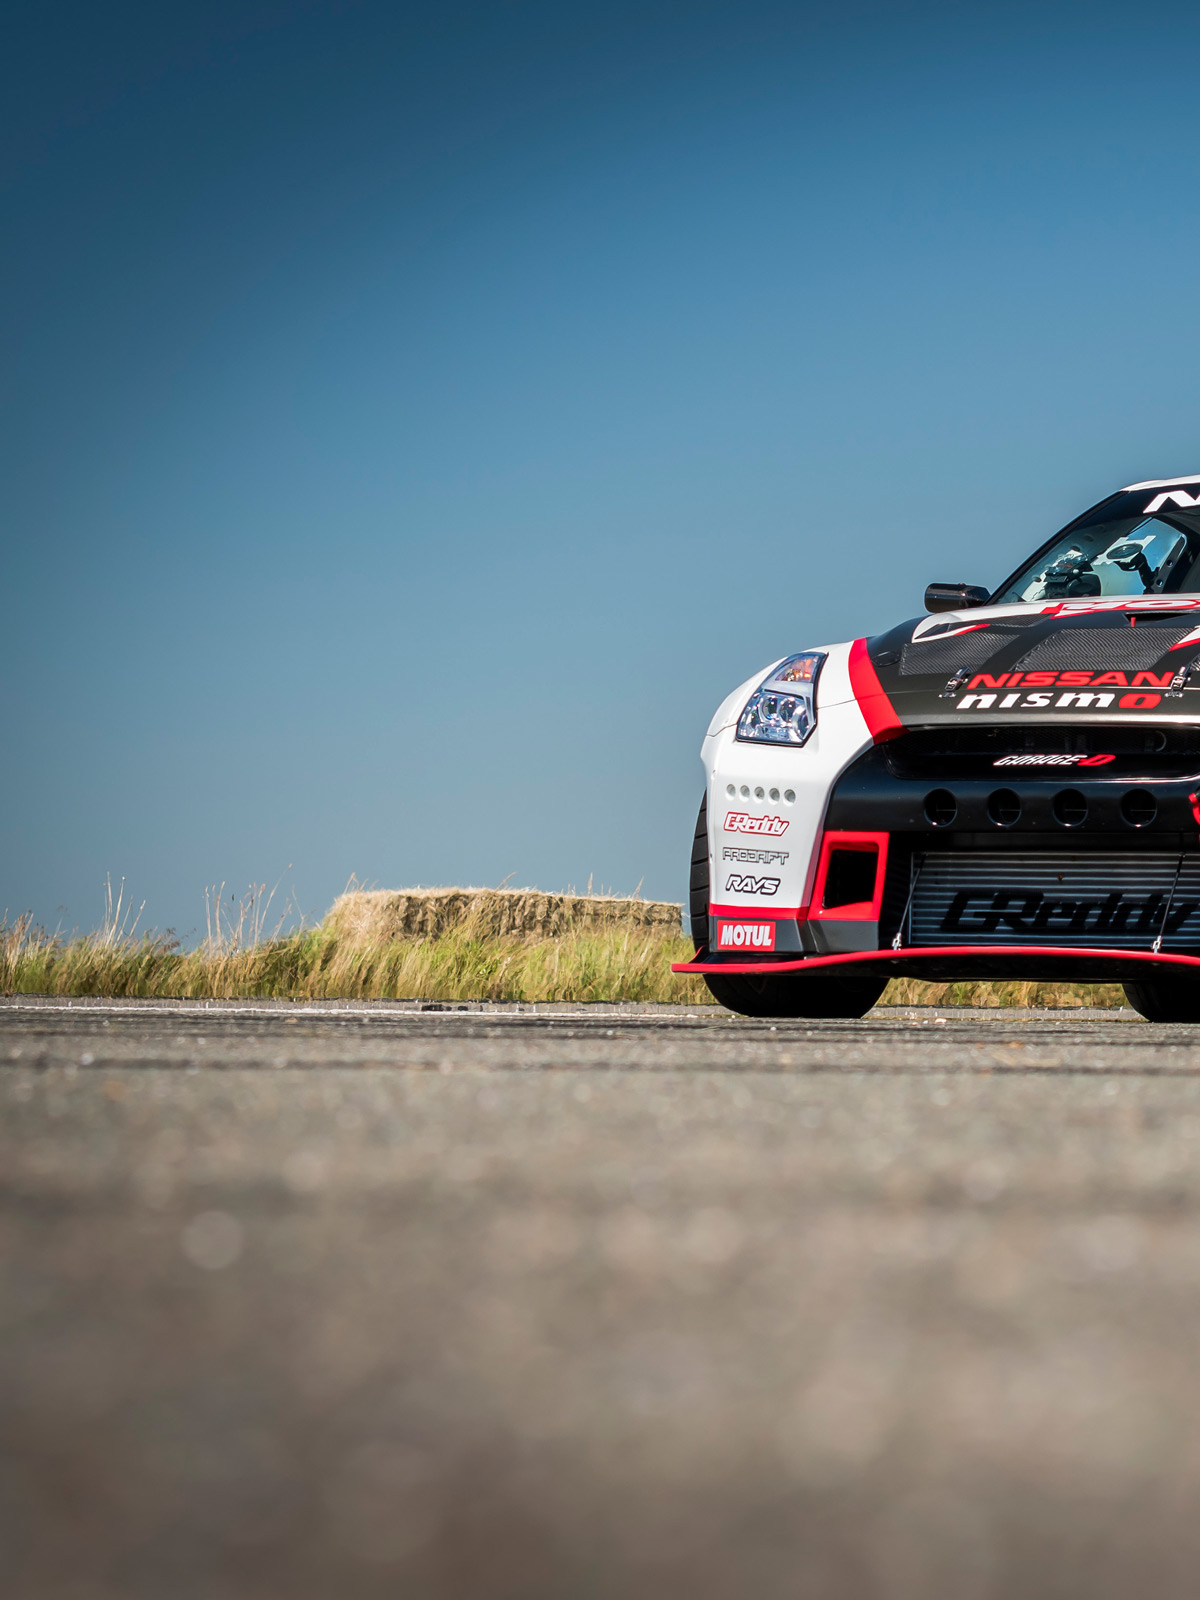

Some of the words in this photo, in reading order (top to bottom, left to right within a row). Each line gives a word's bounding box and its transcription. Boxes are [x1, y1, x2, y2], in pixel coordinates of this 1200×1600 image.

[967, 671, 1175, 689] NISSAN
[956, 692, 1162, 709] nismo
[724, 812, 790, 837] GReddy
[722, 847, 789, 865] PRODRIFT
[725, 873, 781, 895] RAYS
[720, 925, 773, 947] MOTUL
